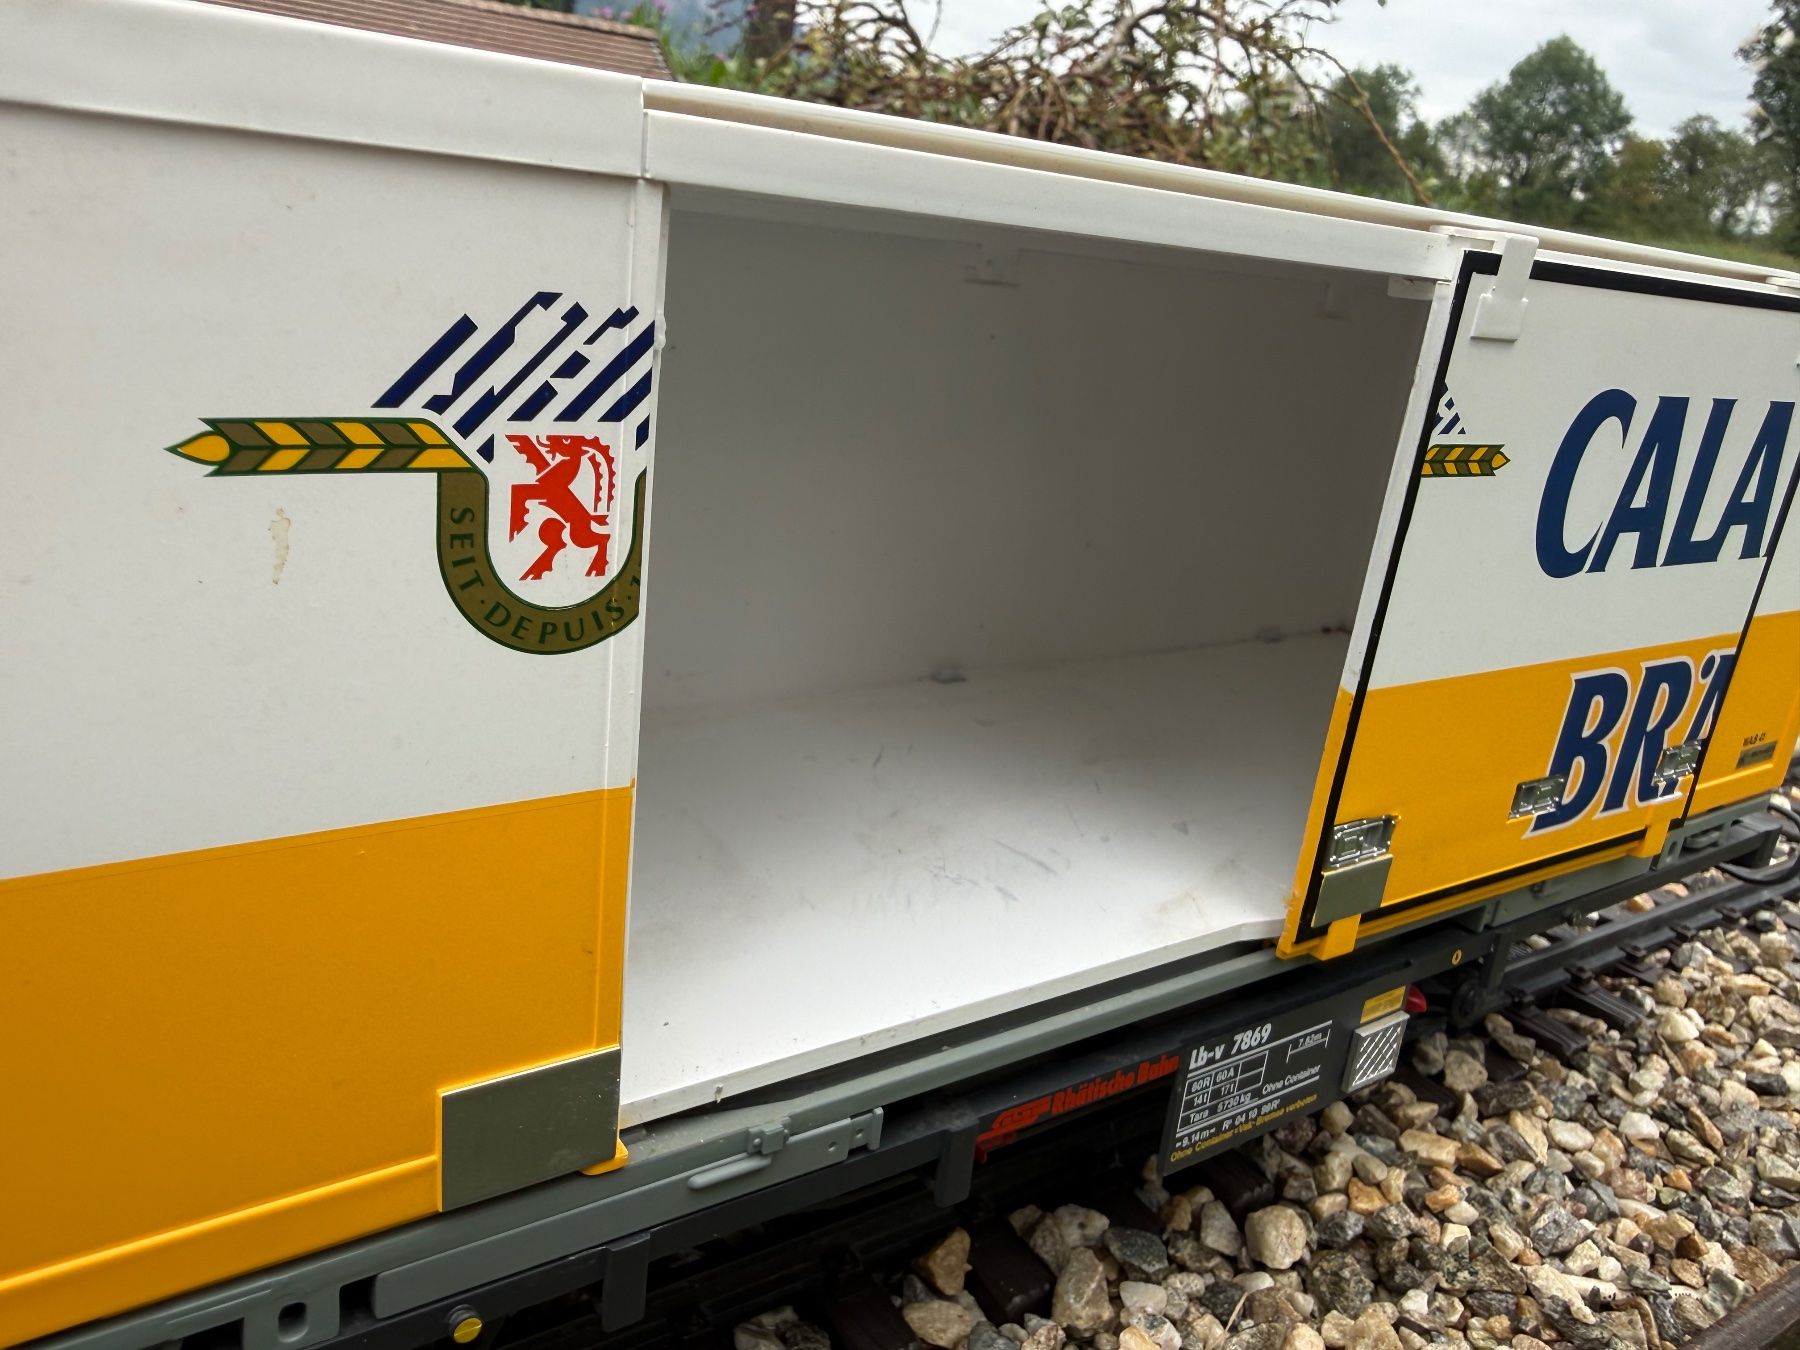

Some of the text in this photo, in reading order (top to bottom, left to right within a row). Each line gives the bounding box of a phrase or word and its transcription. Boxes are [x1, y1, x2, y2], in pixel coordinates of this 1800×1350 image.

[1536, 388, 1796, 579] CALA
[450, 507, 625, 645] SEIT DEPUIS
[1189, 1023, 1272, 1070] Lb-v 7869
[1262, 1064, 1321, 1095] Ohne Container
